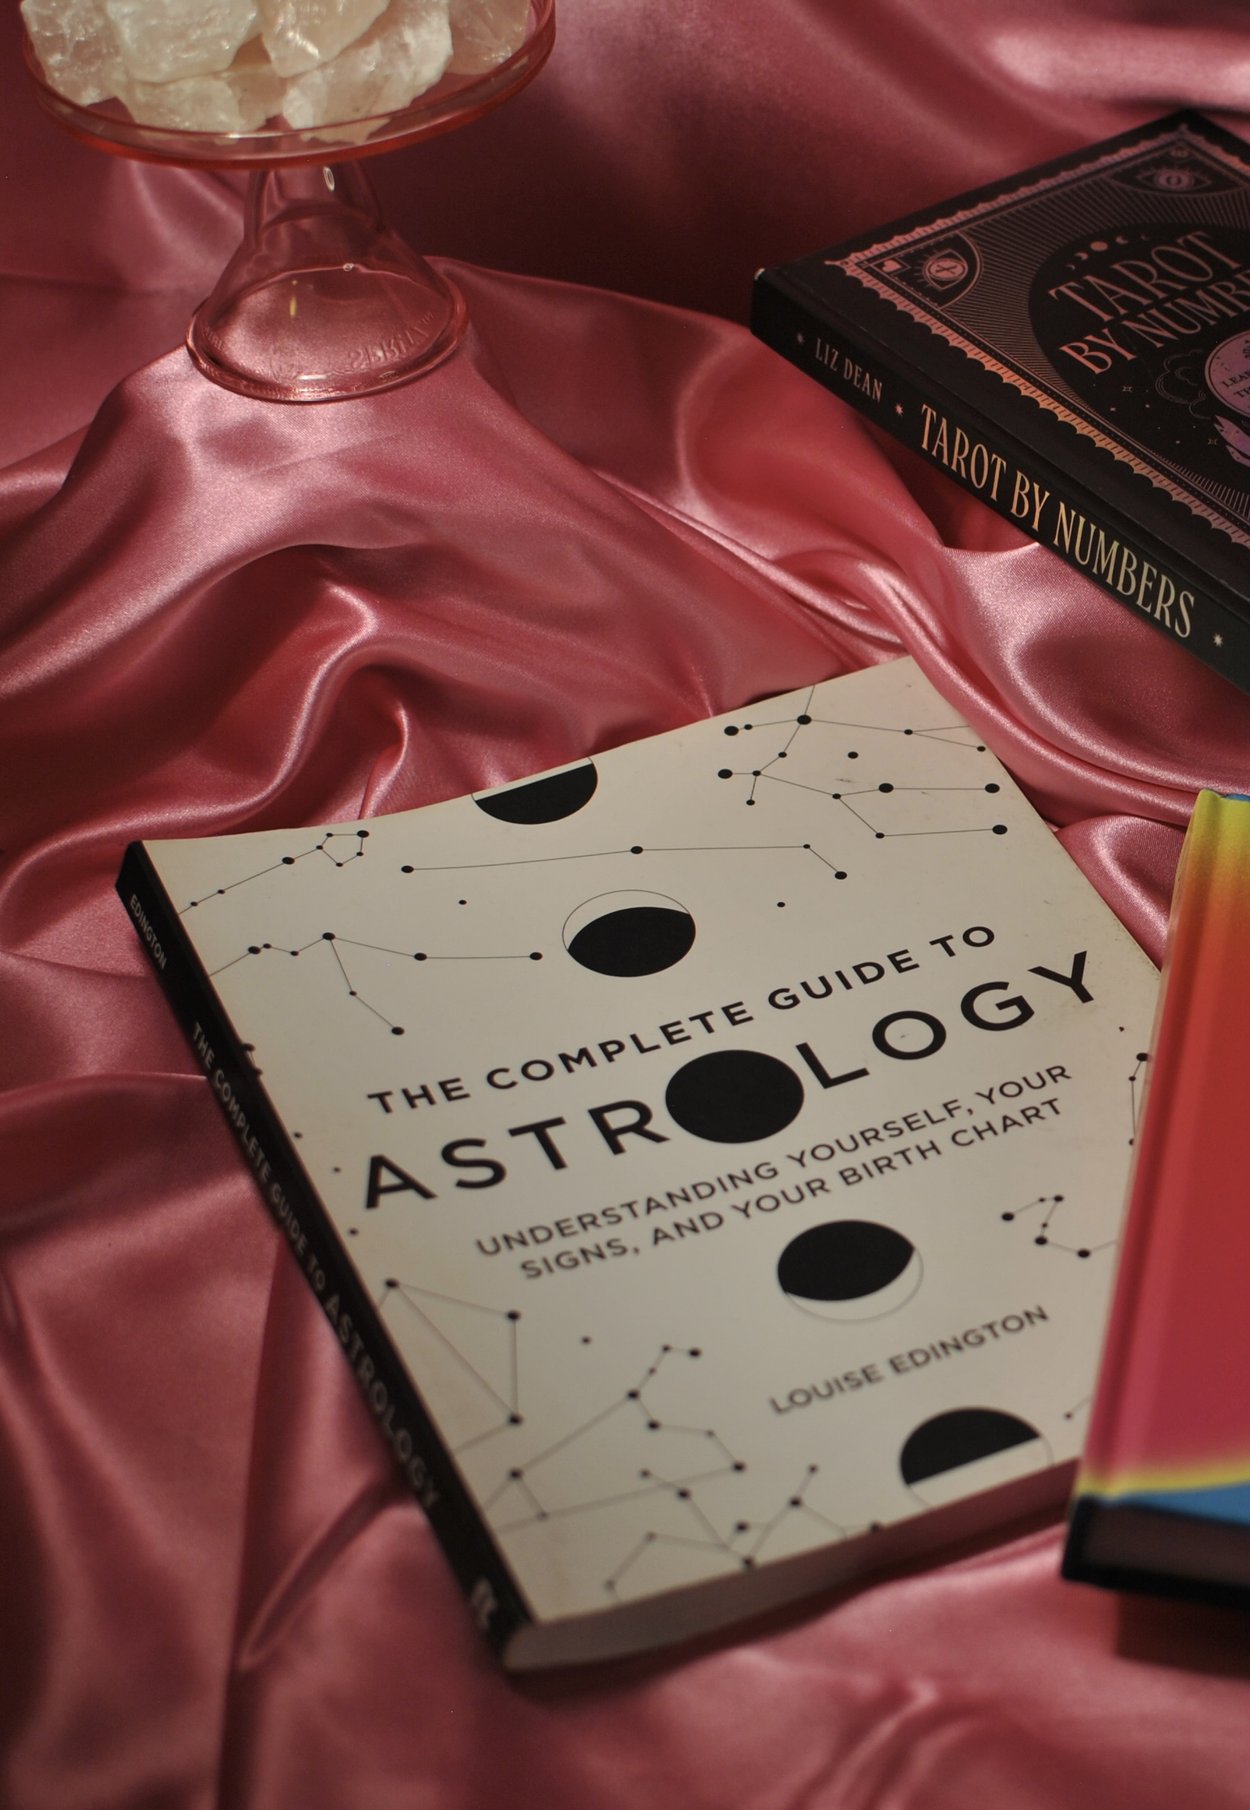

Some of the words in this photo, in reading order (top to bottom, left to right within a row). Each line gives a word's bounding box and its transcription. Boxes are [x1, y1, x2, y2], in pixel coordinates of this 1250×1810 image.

[1049, 231, 1243, 322] TAROT
[1059, 328, 1136, 375] BY
[815, 337, 841, 373] LIZ
[843, 358, 882, 403] DEAN
[921, 404, 1006, 502] TAROT
[1012, 469, 1051, 532] BY
[1053, 502, 1196, 638] NUMBERS
[130, 893, 168, 970] EDINGTON
[367, 1078, 471, 1114] THE
[486, 1001, 754, 1090] COMPLETE
[768, 949, 920, 1010] GUIDE
[929, 926, 995, 958] TO
[193, 1022, 216, 1070] THE
[213, 1069, 272, 1184] COMPLETE
[271, 1183, 308, 1256] GUIDE
[308, 1254, 326, 1293] TO
[476, 1161, 779, 1257] UNDERSTANDING
[787, 1098, 975, 1168] YOURSELF,
[975, 1065, 1072, 1105] YOUR
[520, 1237, 640, 1280] SIGNS,
[652, 1211, 724, 1247] AND
[732, 1177, 830, 1219] YOUR
[838, 1140, 942, 1187] BIRTH
[951, 1097, 1065, 1148] CHART
[769, 1364, 884, 1415] LOUISE
[888, 1304, 1050, 1375] EDINGTON
